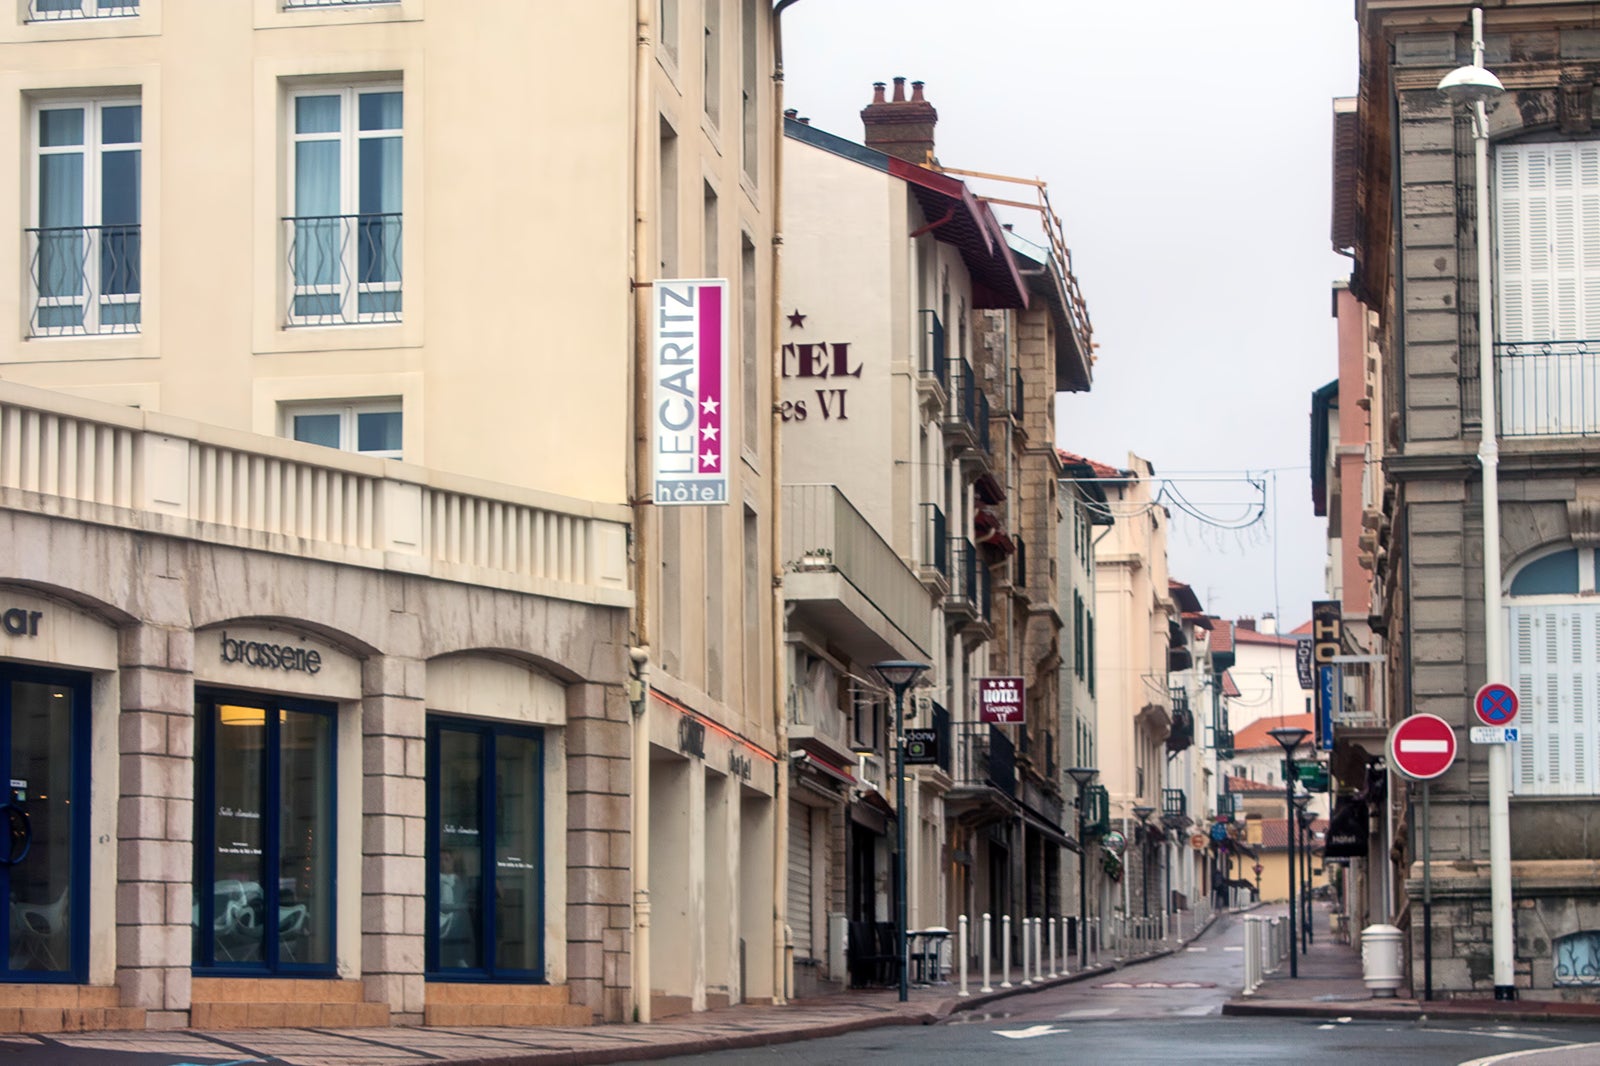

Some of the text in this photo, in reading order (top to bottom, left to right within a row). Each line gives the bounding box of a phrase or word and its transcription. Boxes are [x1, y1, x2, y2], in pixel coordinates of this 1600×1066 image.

[659, 286, 694, 474] LE CARITZ
[815, 389, 848, 420] VI
[658, 483, 723, 501] hôtel
[0, 607, 43, 637] ar
[221, 630, 322, 674] brasserie
[983, 689, 1020, 703] HOTEL
